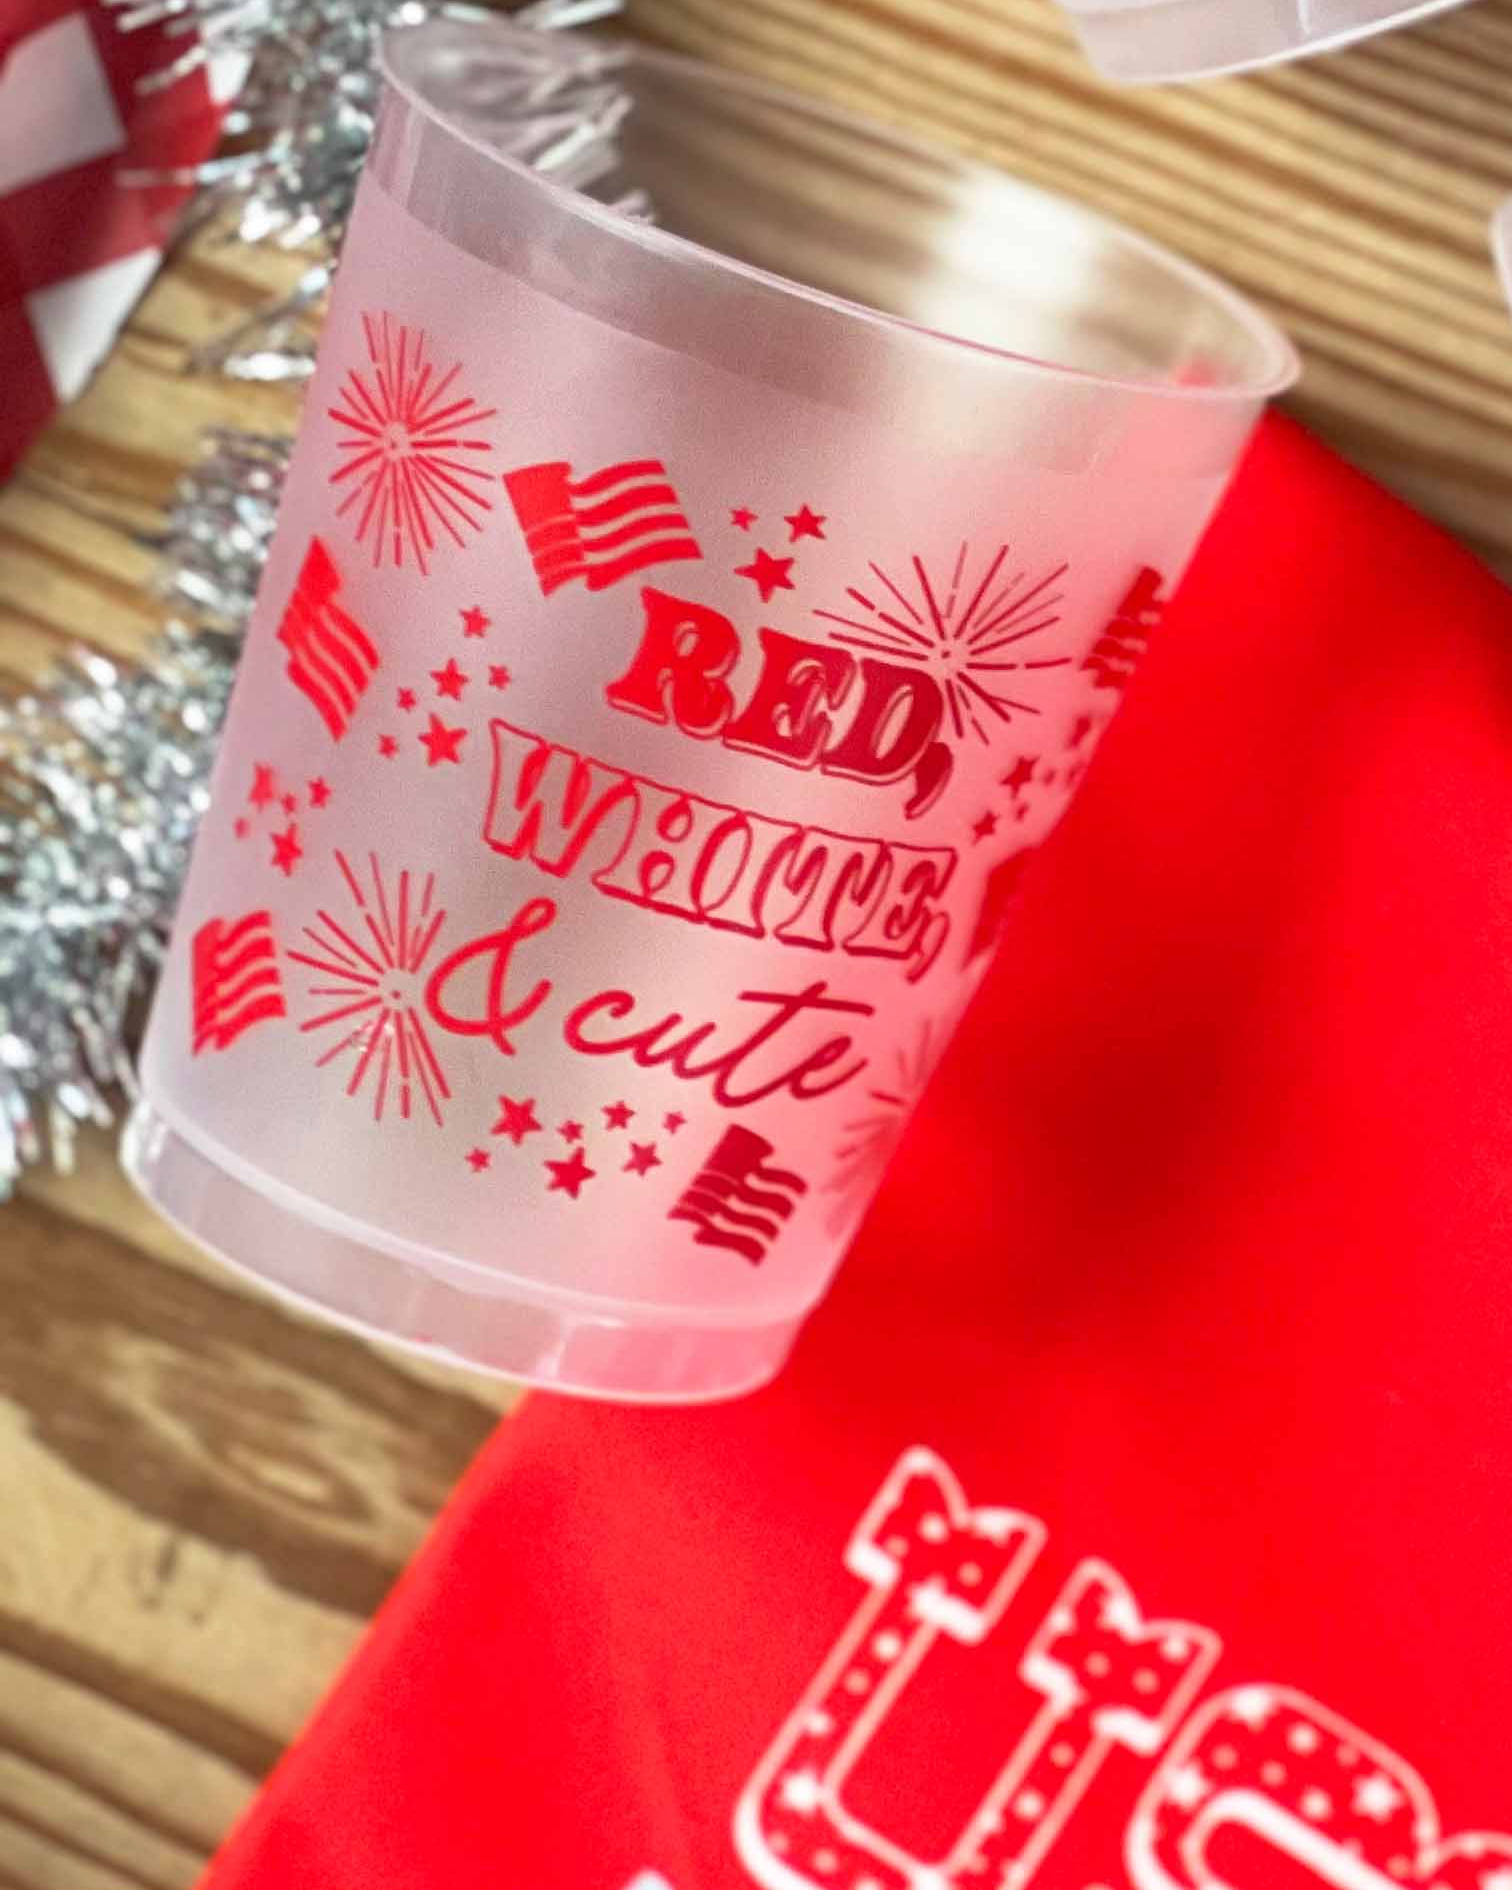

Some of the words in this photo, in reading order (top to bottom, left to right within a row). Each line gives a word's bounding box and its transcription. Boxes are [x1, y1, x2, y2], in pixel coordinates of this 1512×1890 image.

[606, 586, 954, 820] RED,
[483, 718, 958, 984] WHITE,
[425, 897, 556, 1056] &
[563, 982, 874, 1108] cute
